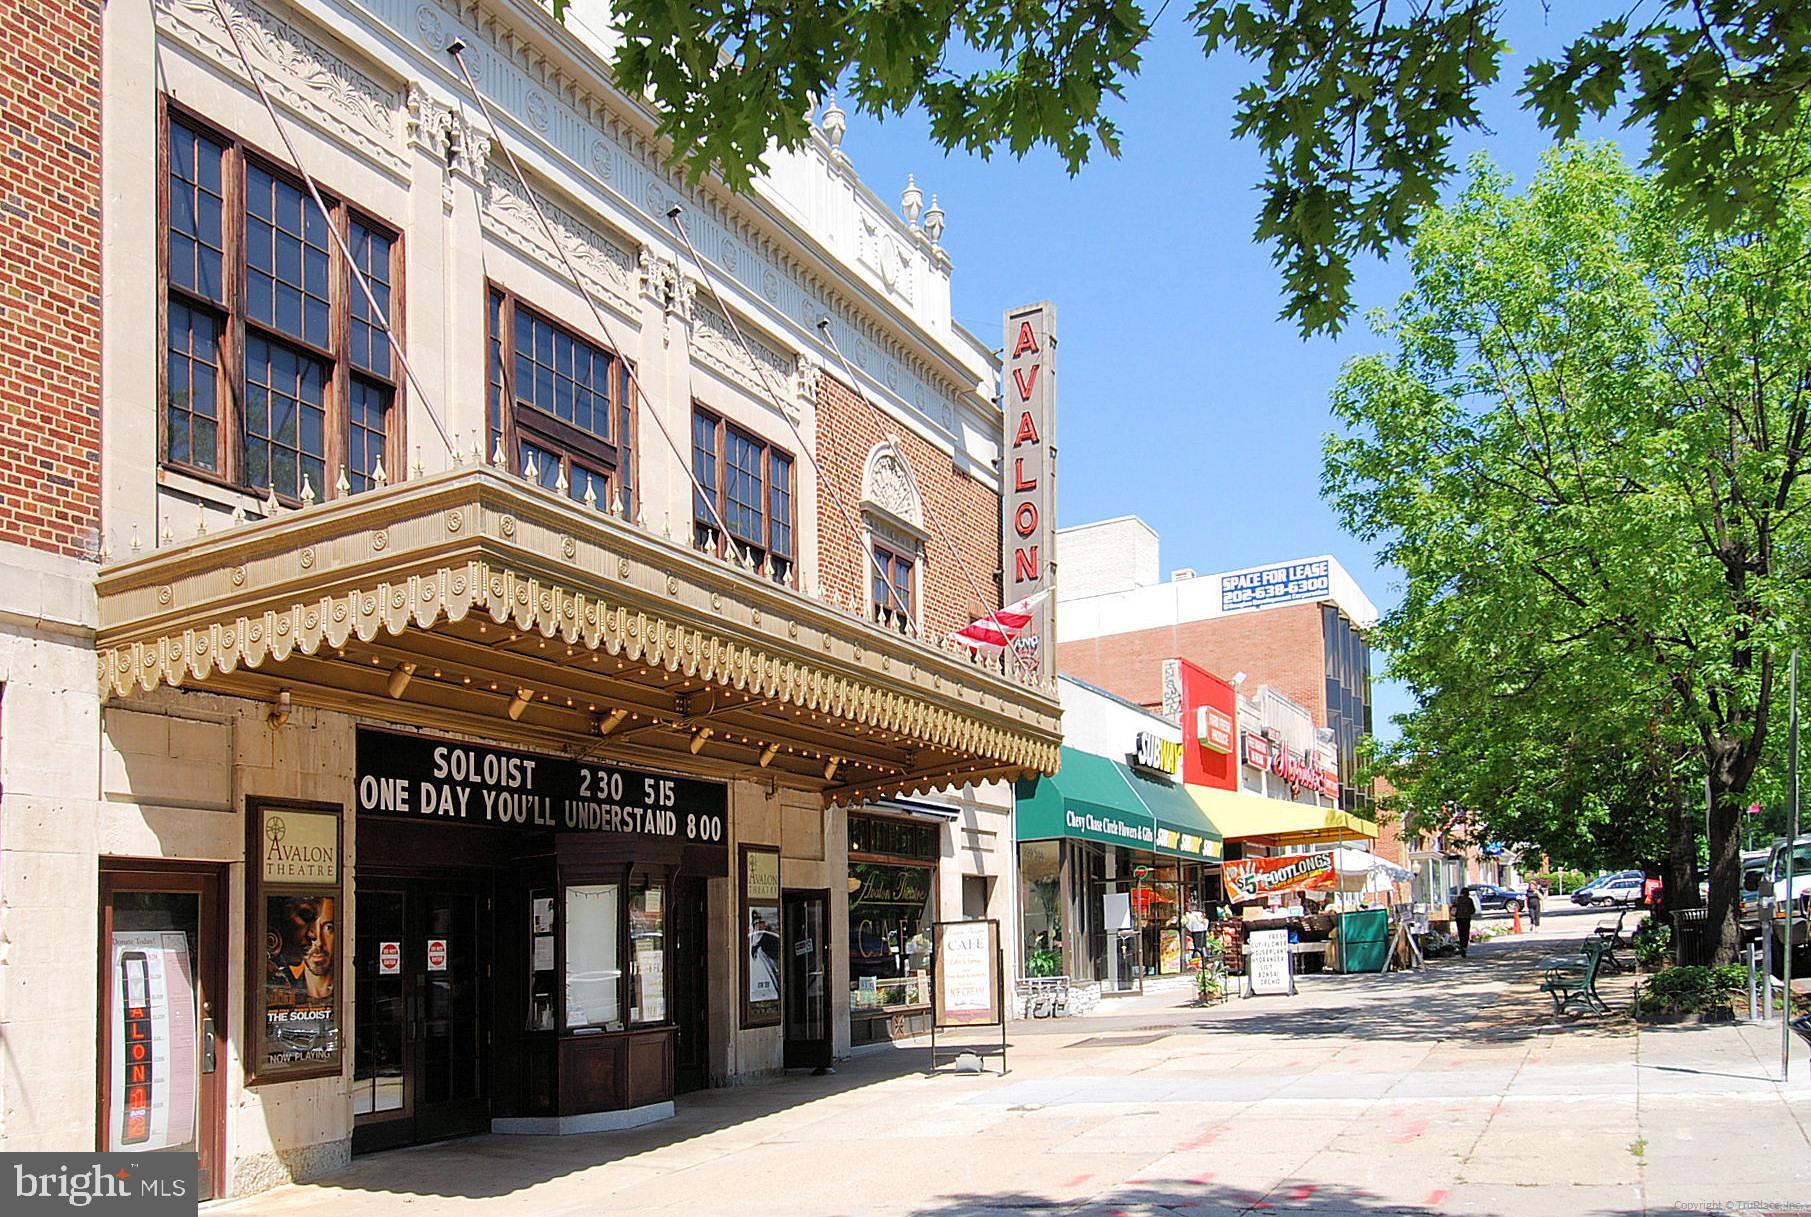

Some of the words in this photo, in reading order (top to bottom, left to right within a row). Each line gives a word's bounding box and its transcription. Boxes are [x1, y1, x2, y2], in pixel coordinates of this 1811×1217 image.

[1012, 321, 1040, 583] AVALON
[1222, 573, 1261, 590] SPACE
[1262, 568, 1288, 585] FOR
[1289, 561, 1328, 581] LEASE
[1222, 576, 1328, 603] 202-638-6300
[1138, 731, 1183, 775] SUBWAY
[433, 746, 536, 790] SOLOIST
[360, 774, 409, 812] ONE
[420, 782, 470, 817] DAY
[482, 790, 555, 827] YOU'LL
[565, 800, 677, 837] UNDERSTAND
[1066, 810, 1085, 832] Chevy
[1086, 814, 1102, 832] Chase
[267, 835, 333, 863] AVALON
[266, 863, 333, 876] THEATRE
[749, 867, 778, 885] AVALON
[1263, 853, 1331, 886] FOOTLONGS
[267, 1013, 288, 1021] THE
[290, 1010, 332, 1020] SOLOIST
[269, 1053, 291, 1064] NOW
[295, 1050, 331, 1061] PLAYING
